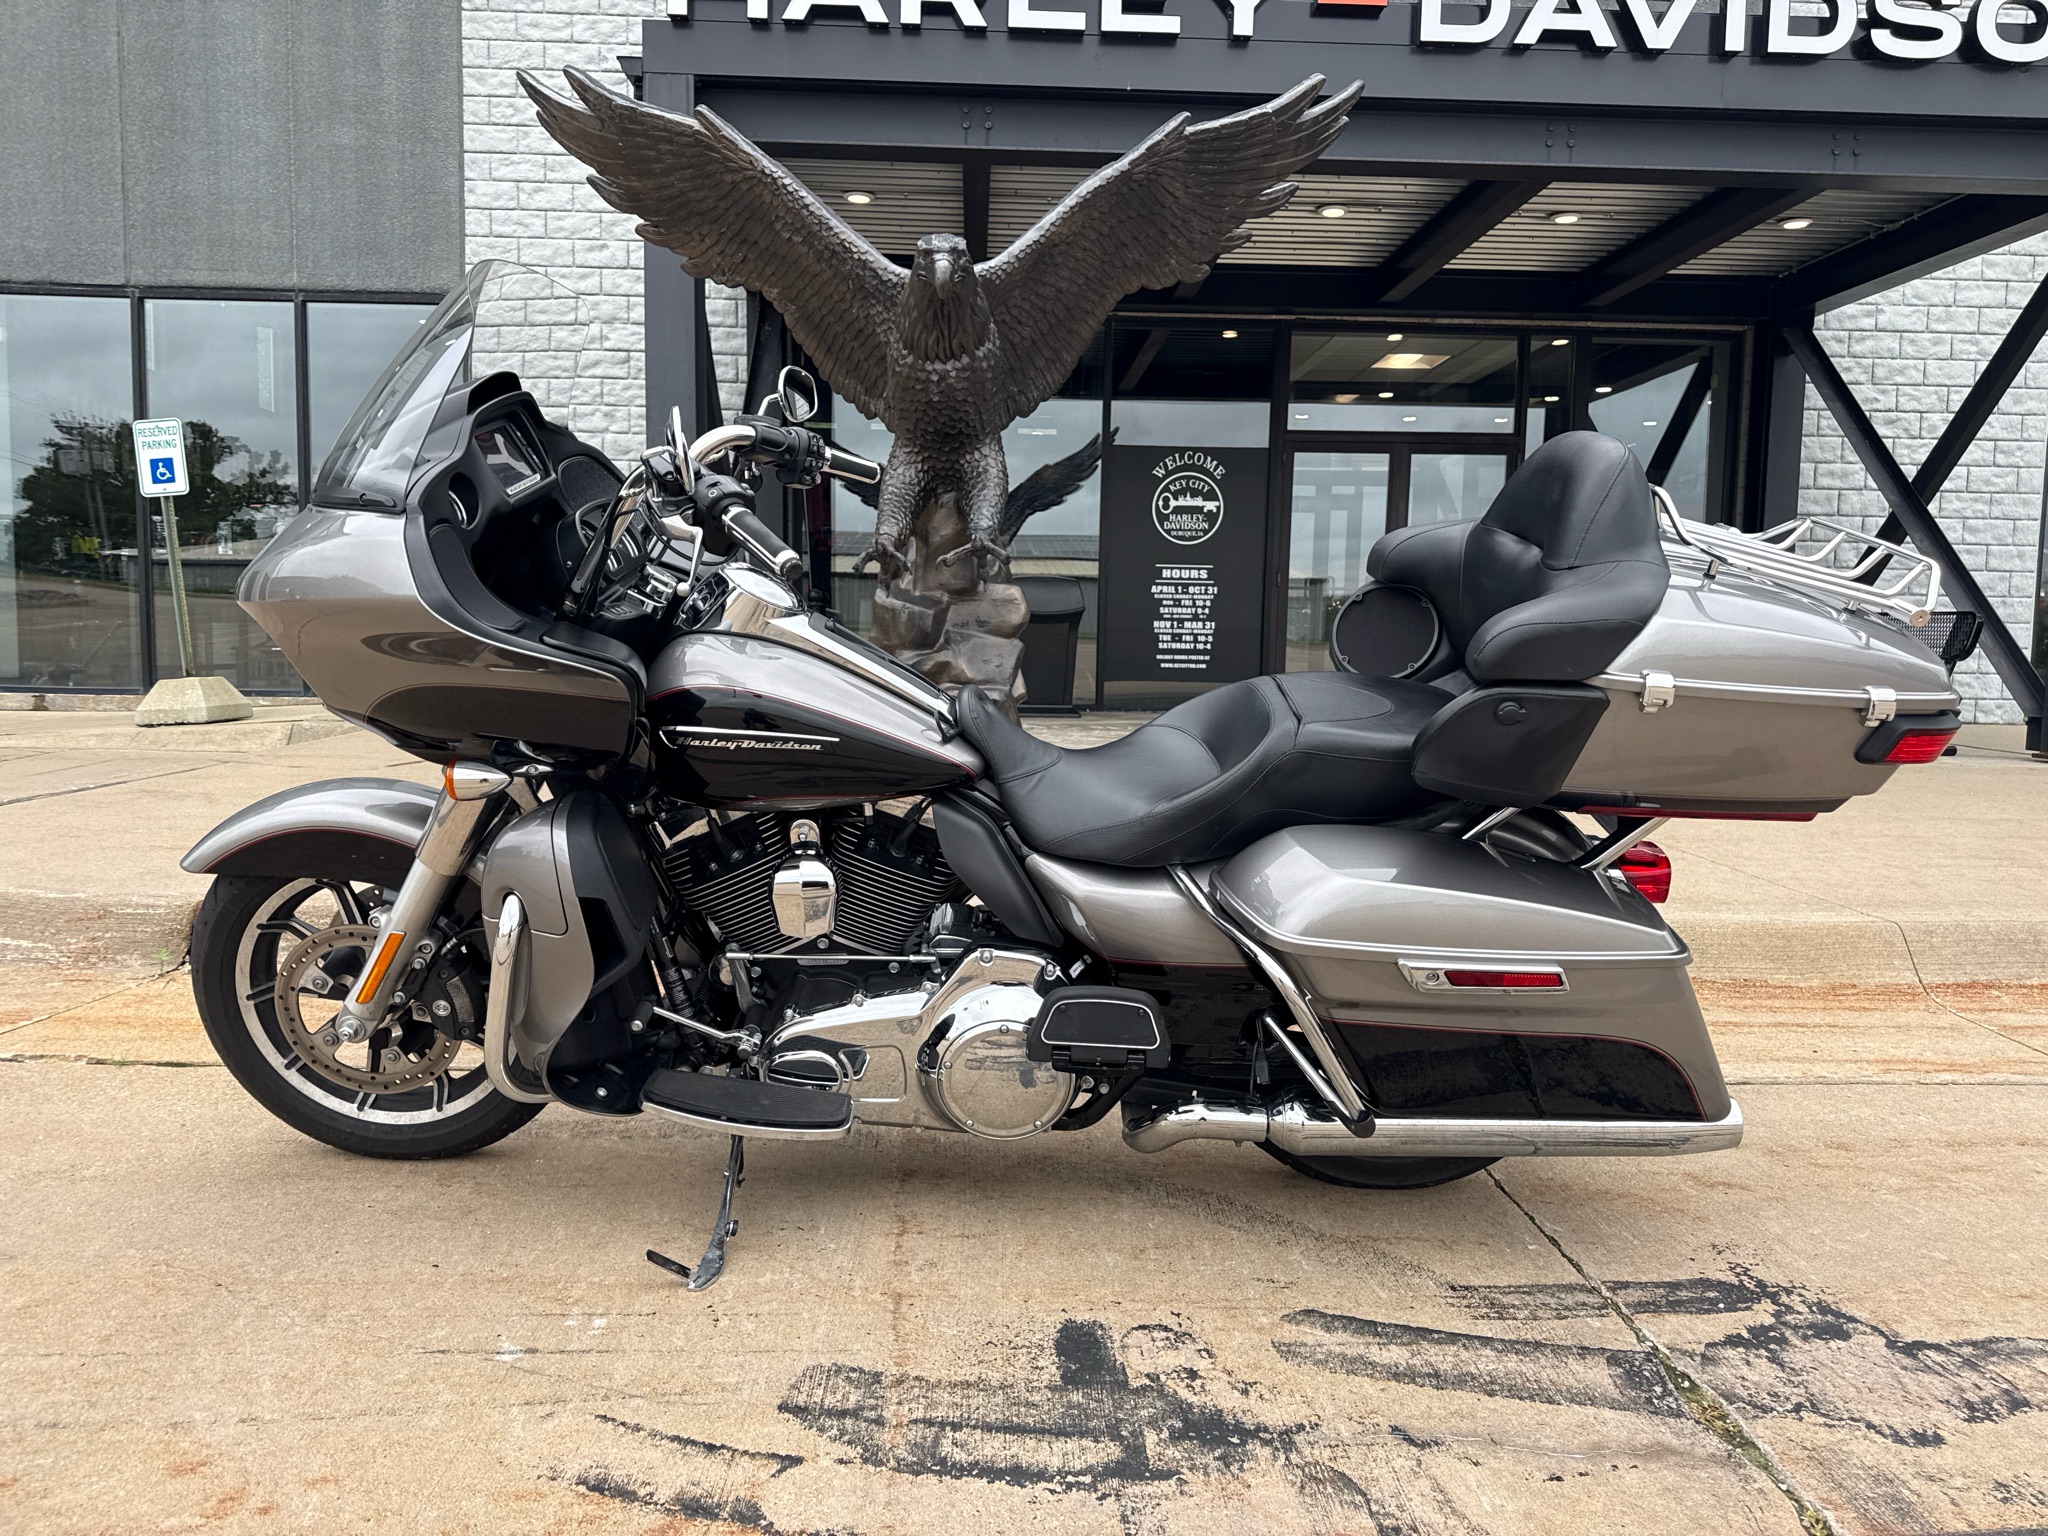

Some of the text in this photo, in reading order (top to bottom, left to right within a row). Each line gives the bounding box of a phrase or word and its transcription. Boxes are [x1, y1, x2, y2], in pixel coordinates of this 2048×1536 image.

[138, 426, 178, 438] RESERVED
[142, 439, 177, 450] PARKING
[1152, 451, 1226, 480] WELCOME
[1168, 479, 1211, 493] KEY CITY
[1169, 514, 1207, 522] HARLEY-
[1164, 521, 1209, 530] DAVIDSON
[1162, 568, 1208, 578] HOURS
[1151, 585, 1176, 593] APRIL
[1188, 586, 1206, 594] OCT
[1207, 586, 1218, 594] 31
[1173, 620, 1177, 628] 1
